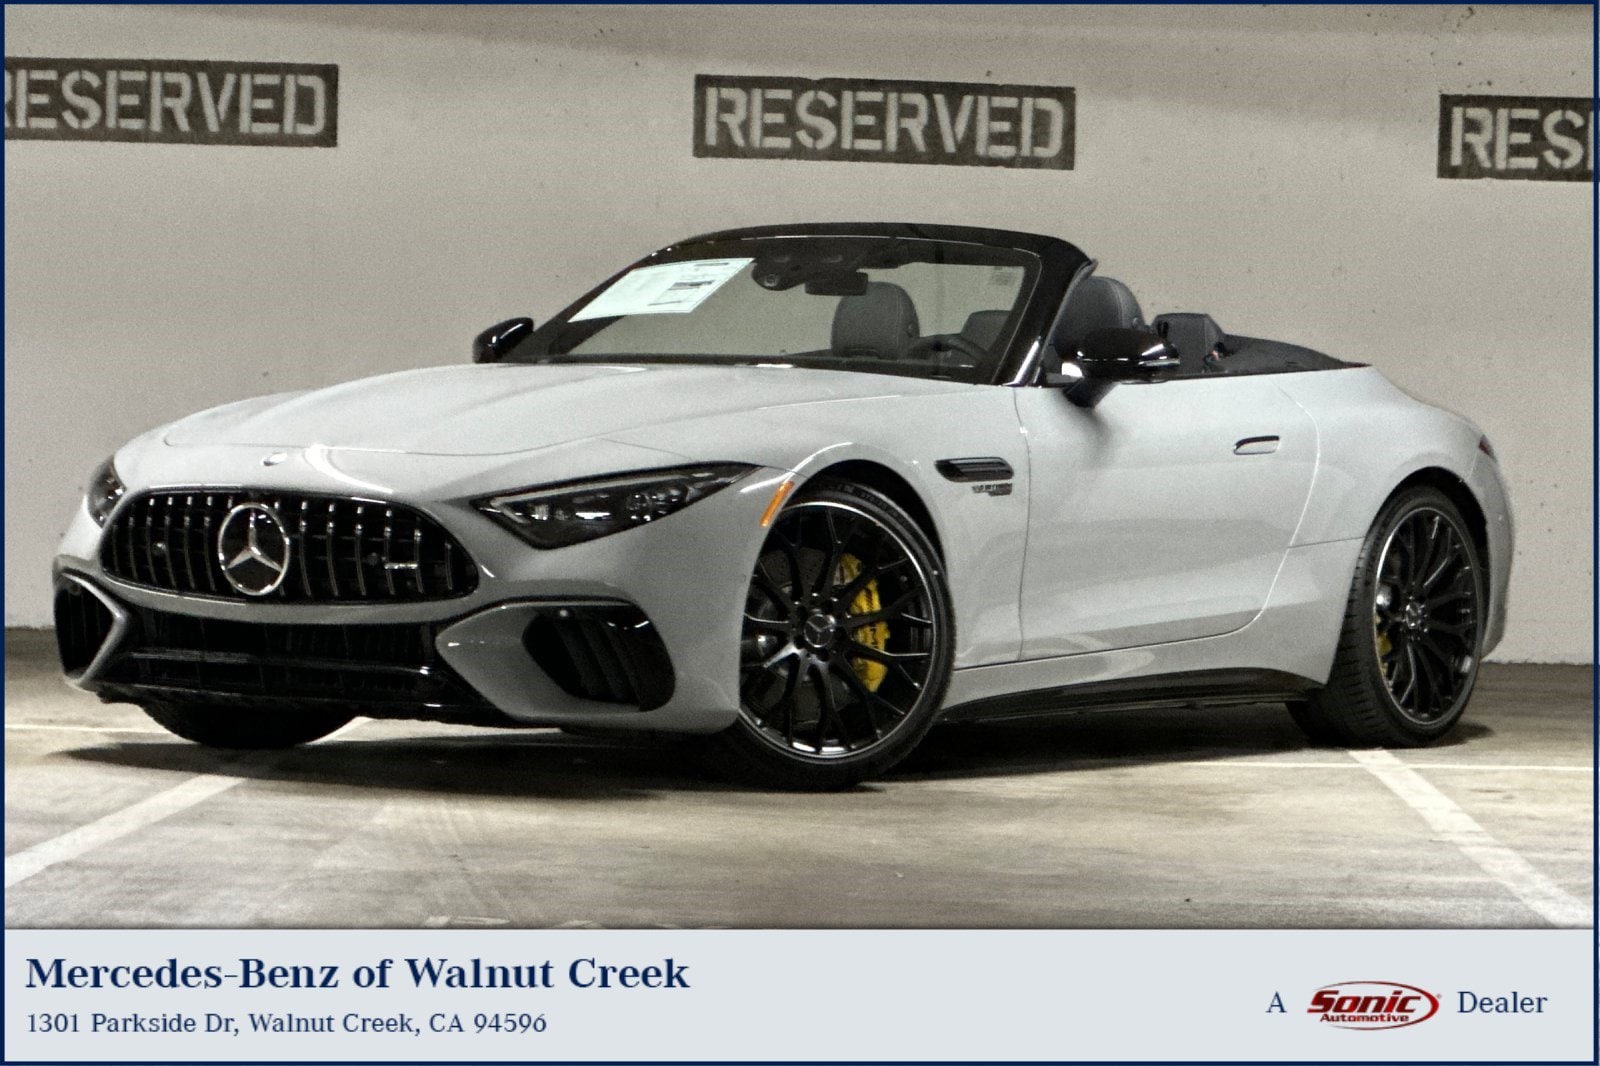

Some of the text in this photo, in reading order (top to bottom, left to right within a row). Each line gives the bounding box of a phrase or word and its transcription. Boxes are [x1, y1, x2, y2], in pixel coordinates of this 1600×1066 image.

[5, 69, 327, 135] ESERVED
[705, 86, 1065, 158] RESERVED
[1451, 106, 1594, 170] RES
